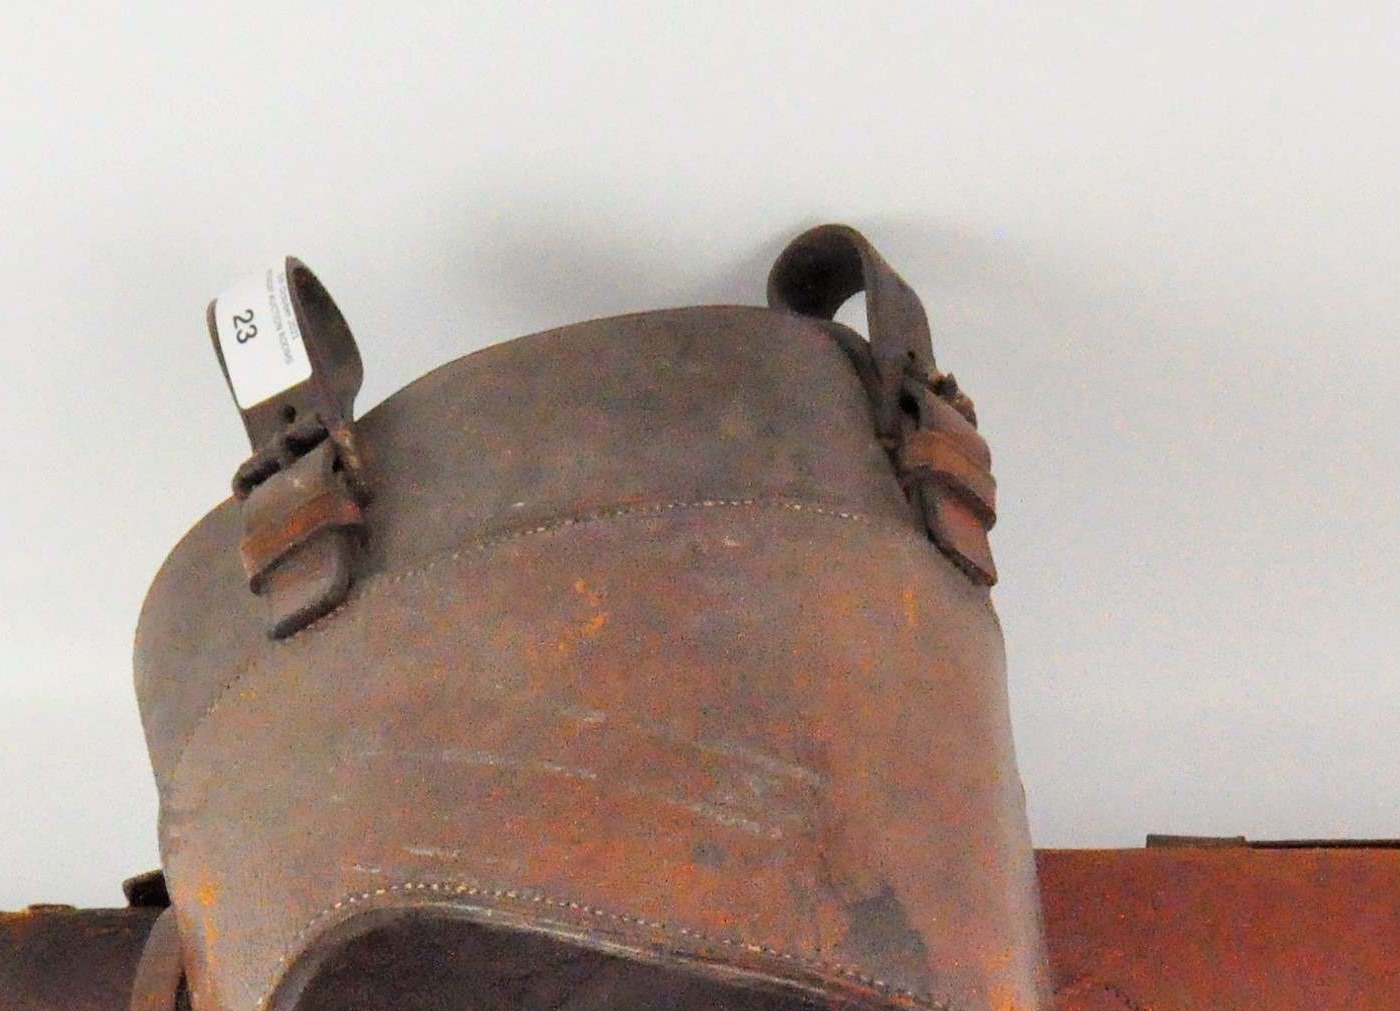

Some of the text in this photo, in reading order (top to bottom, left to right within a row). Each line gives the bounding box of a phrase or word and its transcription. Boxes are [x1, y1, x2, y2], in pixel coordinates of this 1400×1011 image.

[233, 308, 258, 344] 23
[268, 294, 282, 331] AUCTION
[279, 331, 294, 365] ROOMS
